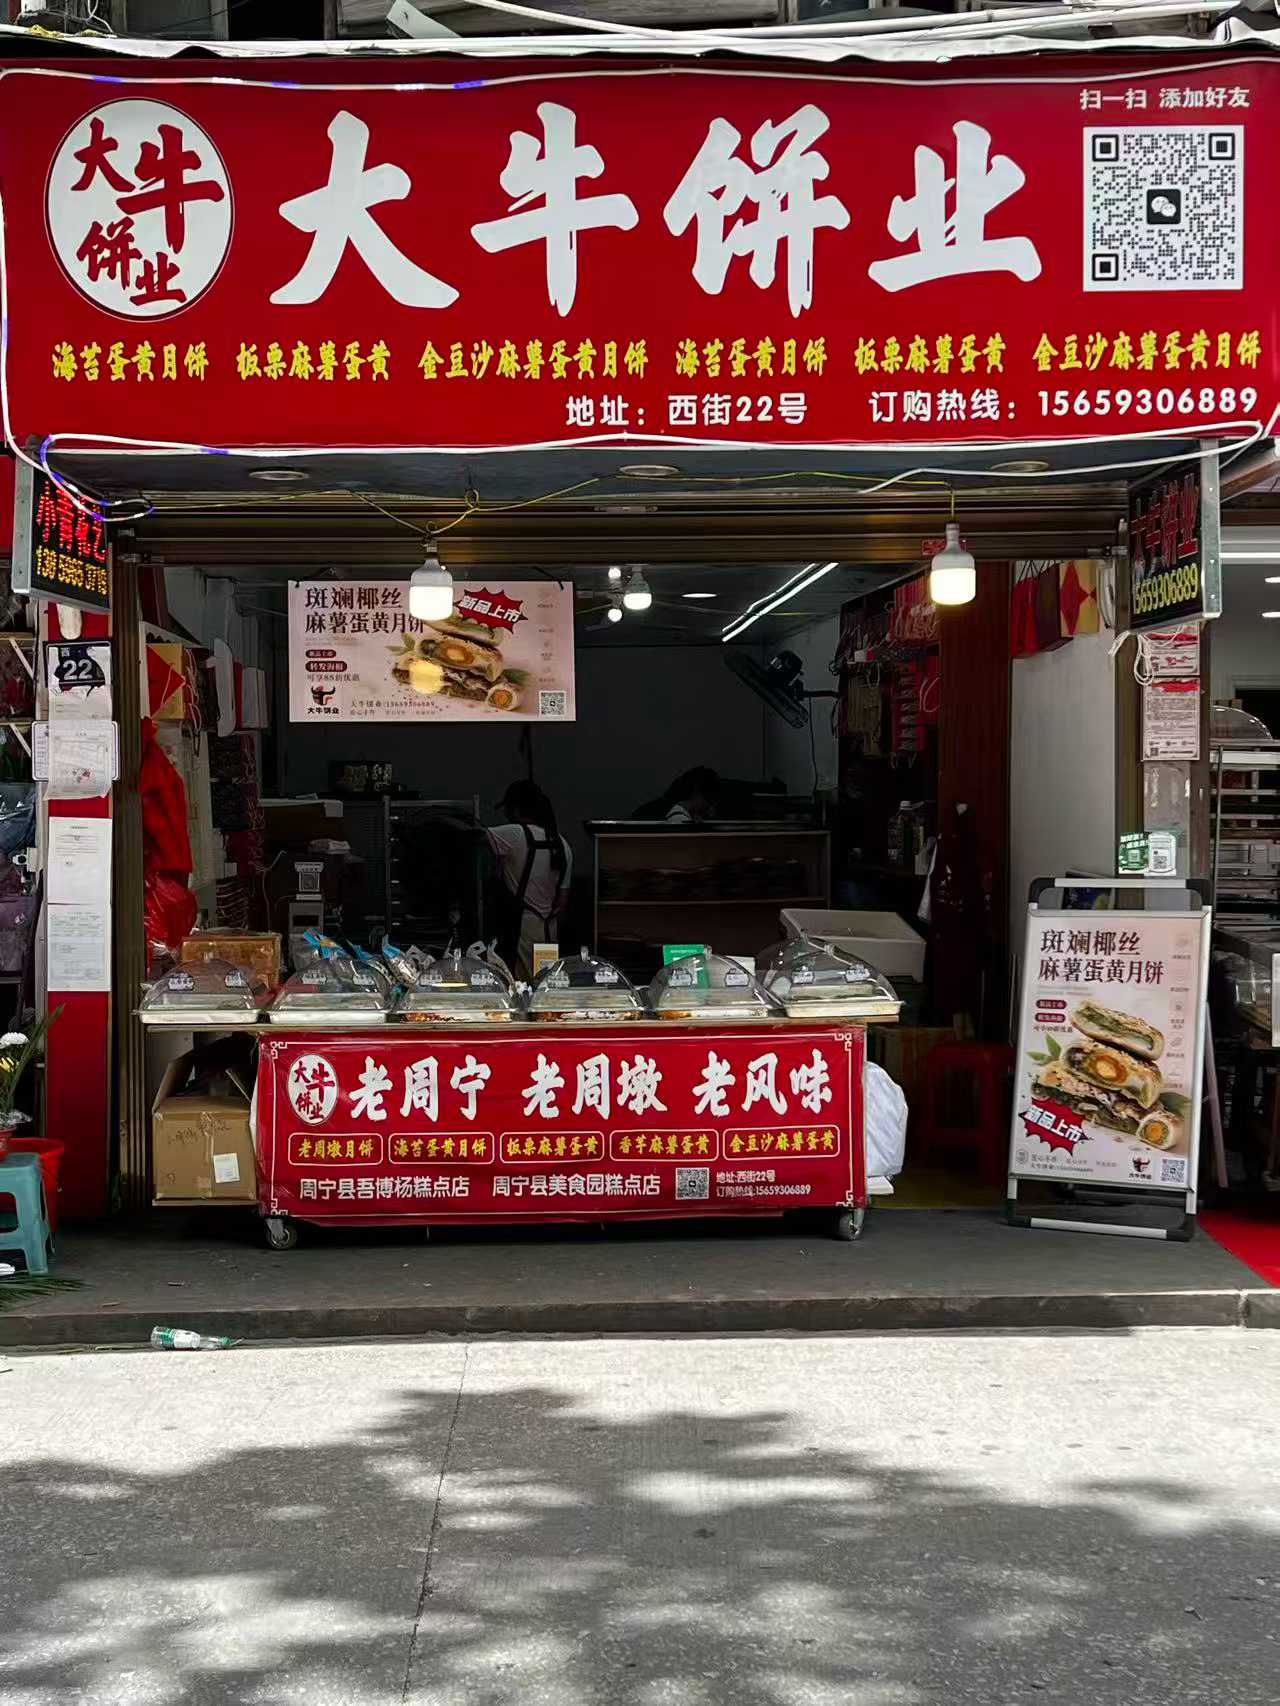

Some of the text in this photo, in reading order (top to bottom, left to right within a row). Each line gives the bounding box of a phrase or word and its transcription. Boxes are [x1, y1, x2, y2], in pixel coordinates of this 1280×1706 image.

[1080, 87, 1250, 110] 扫一扫 添加好友
[270, 102, 1042, 318] 大牛饼业
[52, 329, 1262, 382] 海苔蛋黄月饼 板栗麻薯蛋黄 金豆沙麻薯蛋黄月饼 海苔蛋黄月饼 板栗麻薯蛋黄 金豆沙麻薯蛋黄月饼
[305, 587, 402, 610] 斑斓椰丝
[458, 596, 520, 623] 新品上市
[305, 612, 424, 634] 麻薯蛋黄月饼
[63, 659, 93, 680] 22
[1040, 929, 1141, 956] 斑斓椰丝
[1038, 957, 1164, 985] 麻薯蛋黄月饼
[349, 1049, 833, 1122] 老周宁 老周墩 老风味
[1024, 1105, 1082, 1143] 新品上市
[298, 1130, 836, 1159] 老周墩月饼 海苔蛋黄月饼 板栗麻薯蛋黄 香芋麻薯蛋黄 金豆沙麻薯蛋黄
[299, 1173, 661, 1200] 周宁县吾博杨糕点店 周宁县美食园糕点店
